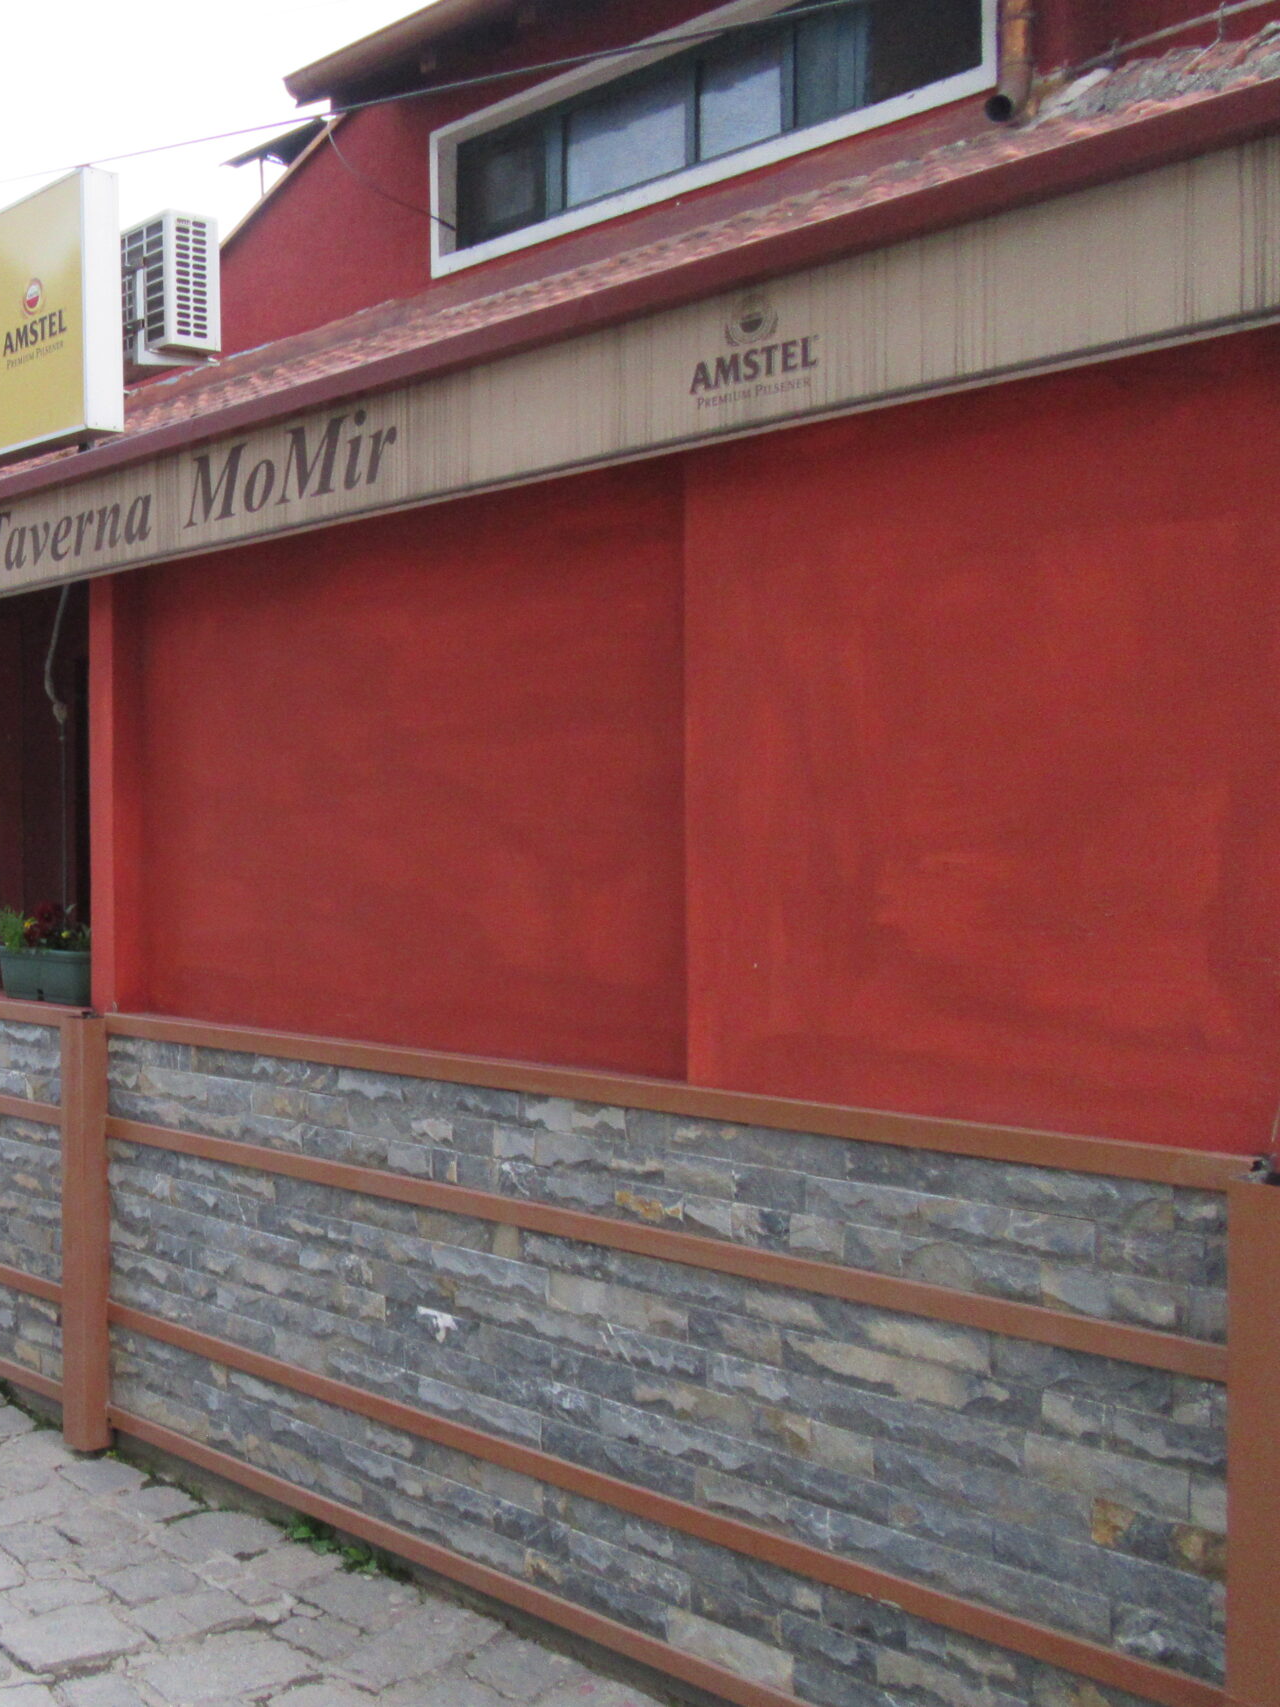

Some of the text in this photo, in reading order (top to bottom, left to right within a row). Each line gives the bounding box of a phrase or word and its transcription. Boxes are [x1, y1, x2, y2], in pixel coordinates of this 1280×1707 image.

[3, 309, 66, 357] AMSTEL
[689, 337, 817, 395] AMSTEL
[697, 377, 812, 409] PREMIUM PILSENER
[183, 410, 398, 531] MoMir
